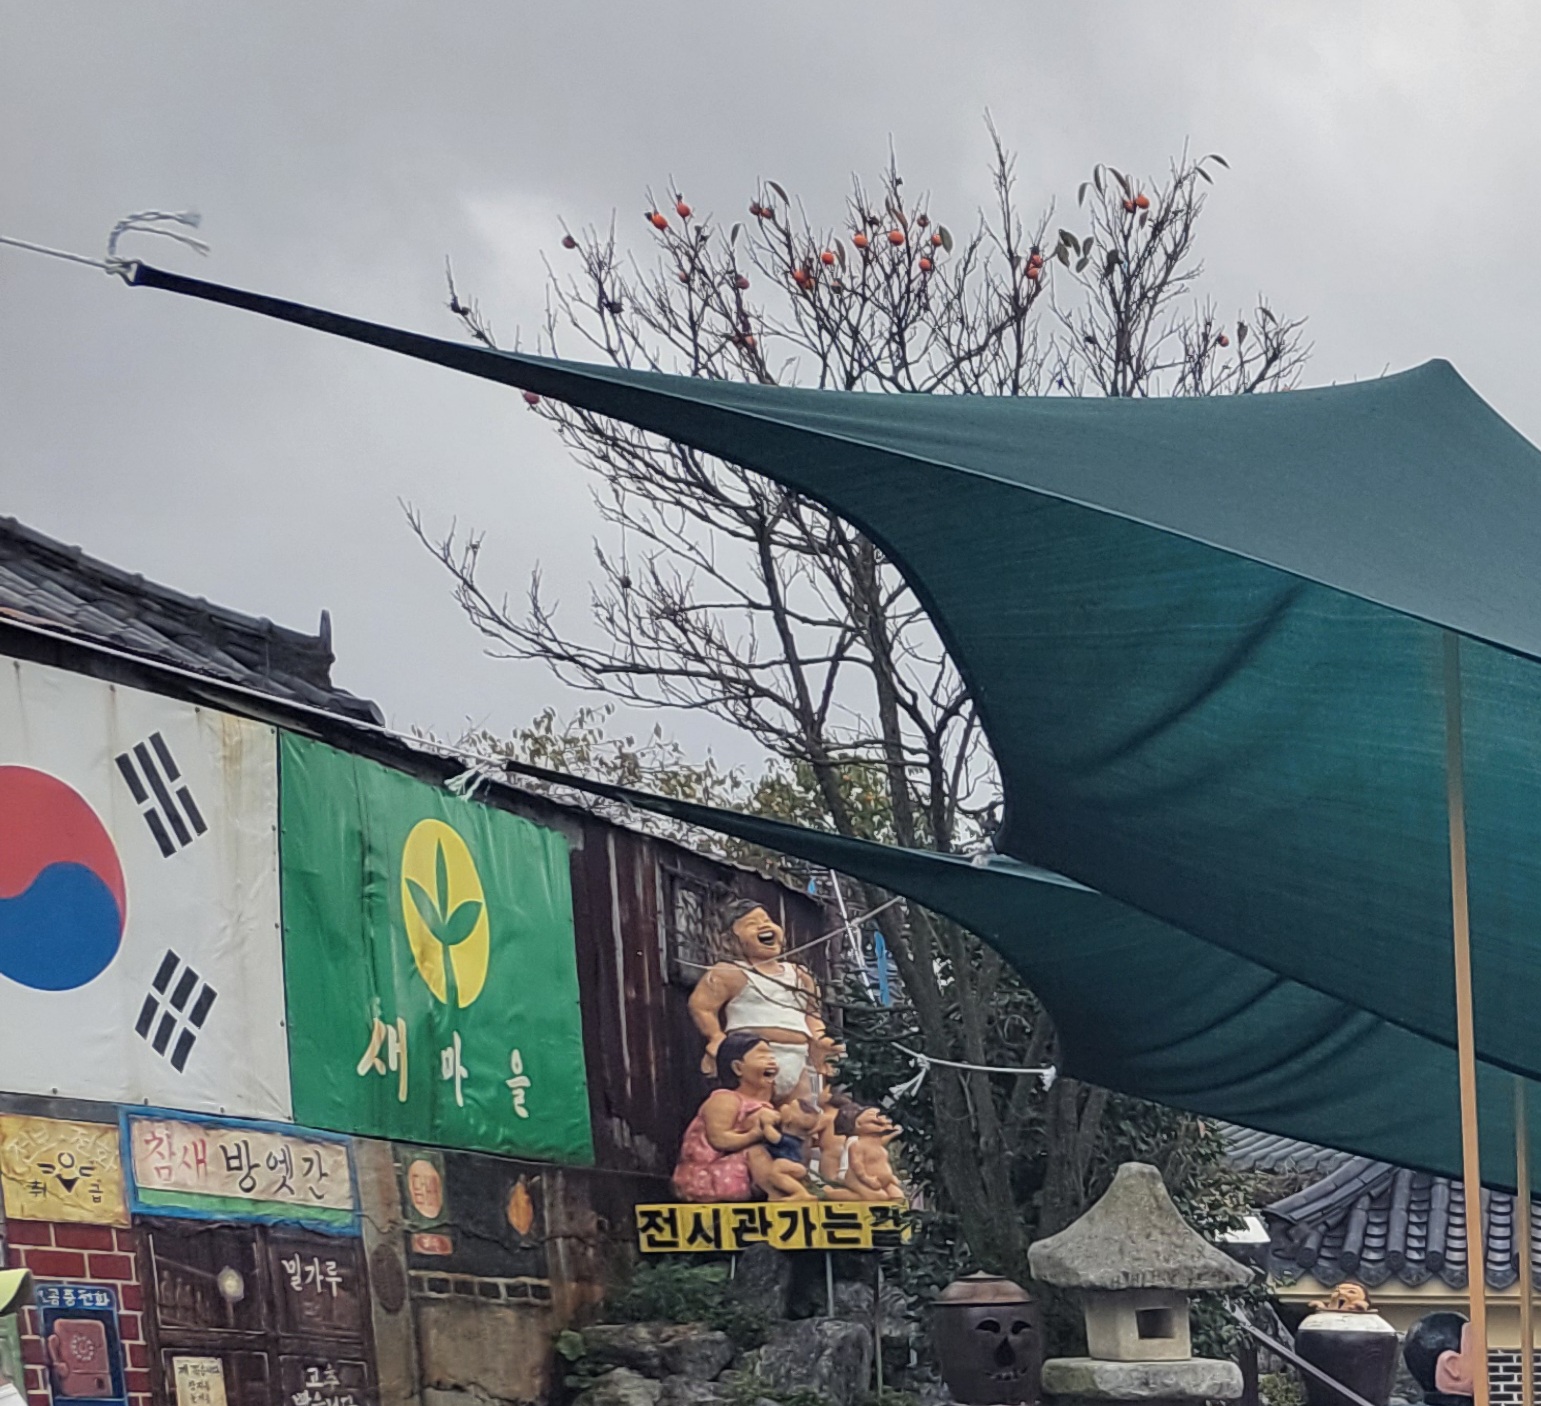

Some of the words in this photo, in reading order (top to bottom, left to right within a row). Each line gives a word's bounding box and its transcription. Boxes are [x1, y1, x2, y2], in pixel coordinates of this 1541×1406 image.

[357, 1016, 531, 1119] 새마을
[142, 1129, 207, 1183] 참새
[305, 1363, 340, 1391] 고추
